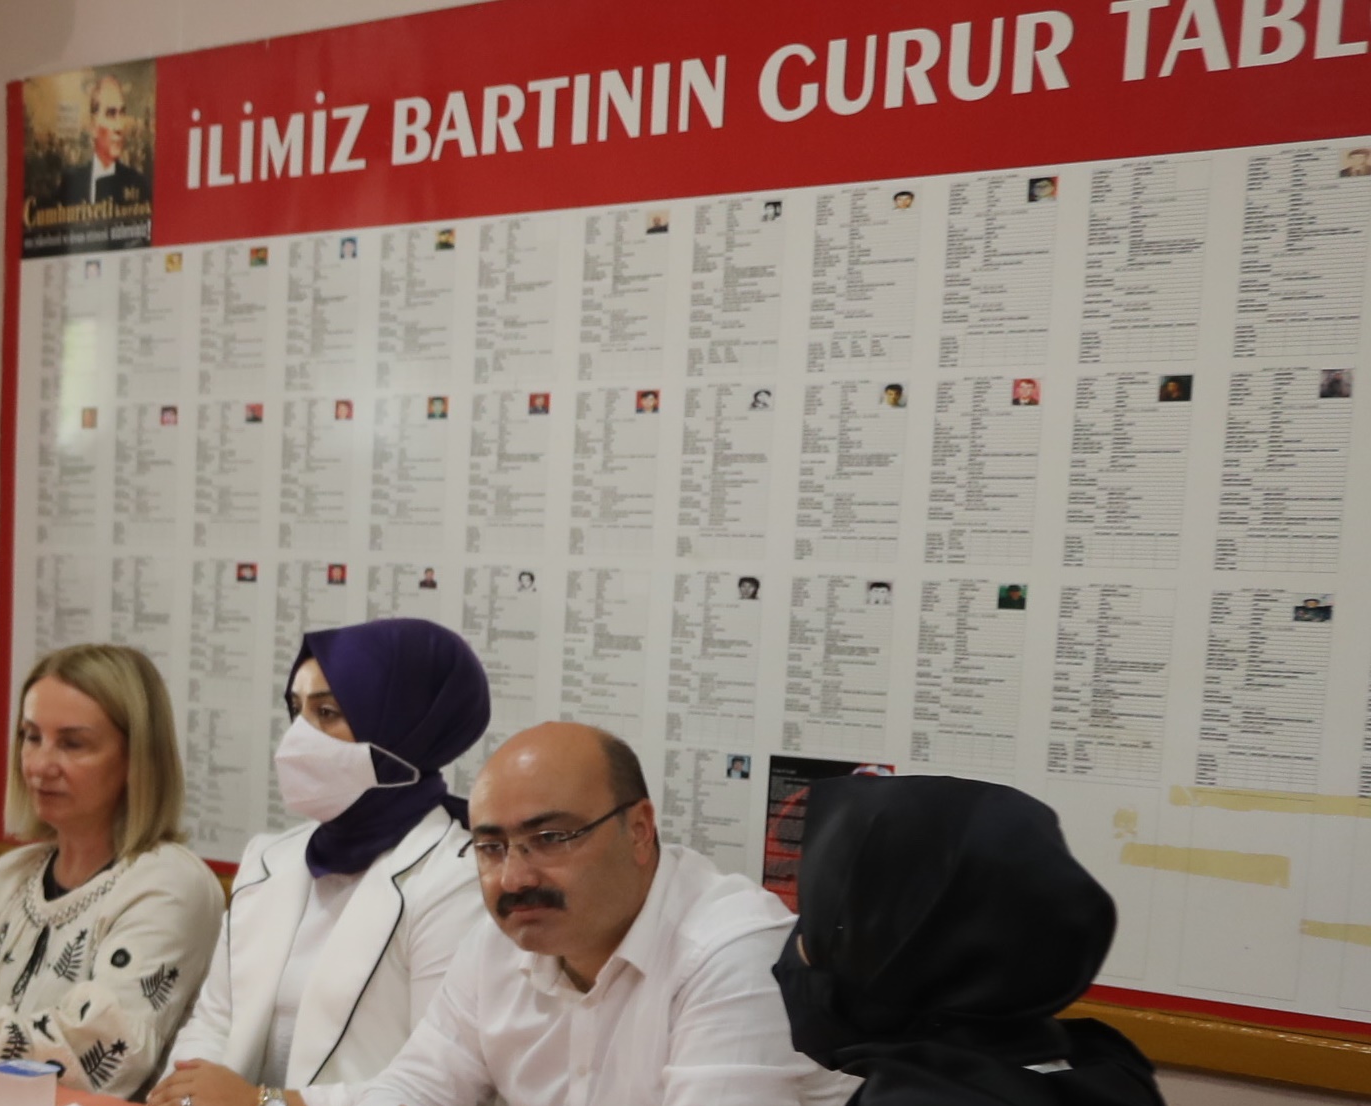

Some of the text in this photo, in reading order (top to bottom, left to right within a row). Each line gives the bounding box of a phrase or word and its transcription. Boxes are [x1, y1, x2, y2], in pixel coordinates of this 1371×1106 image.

[187, 0, 1371, 189] İLİMİZ BARTININ GURUR TABL
